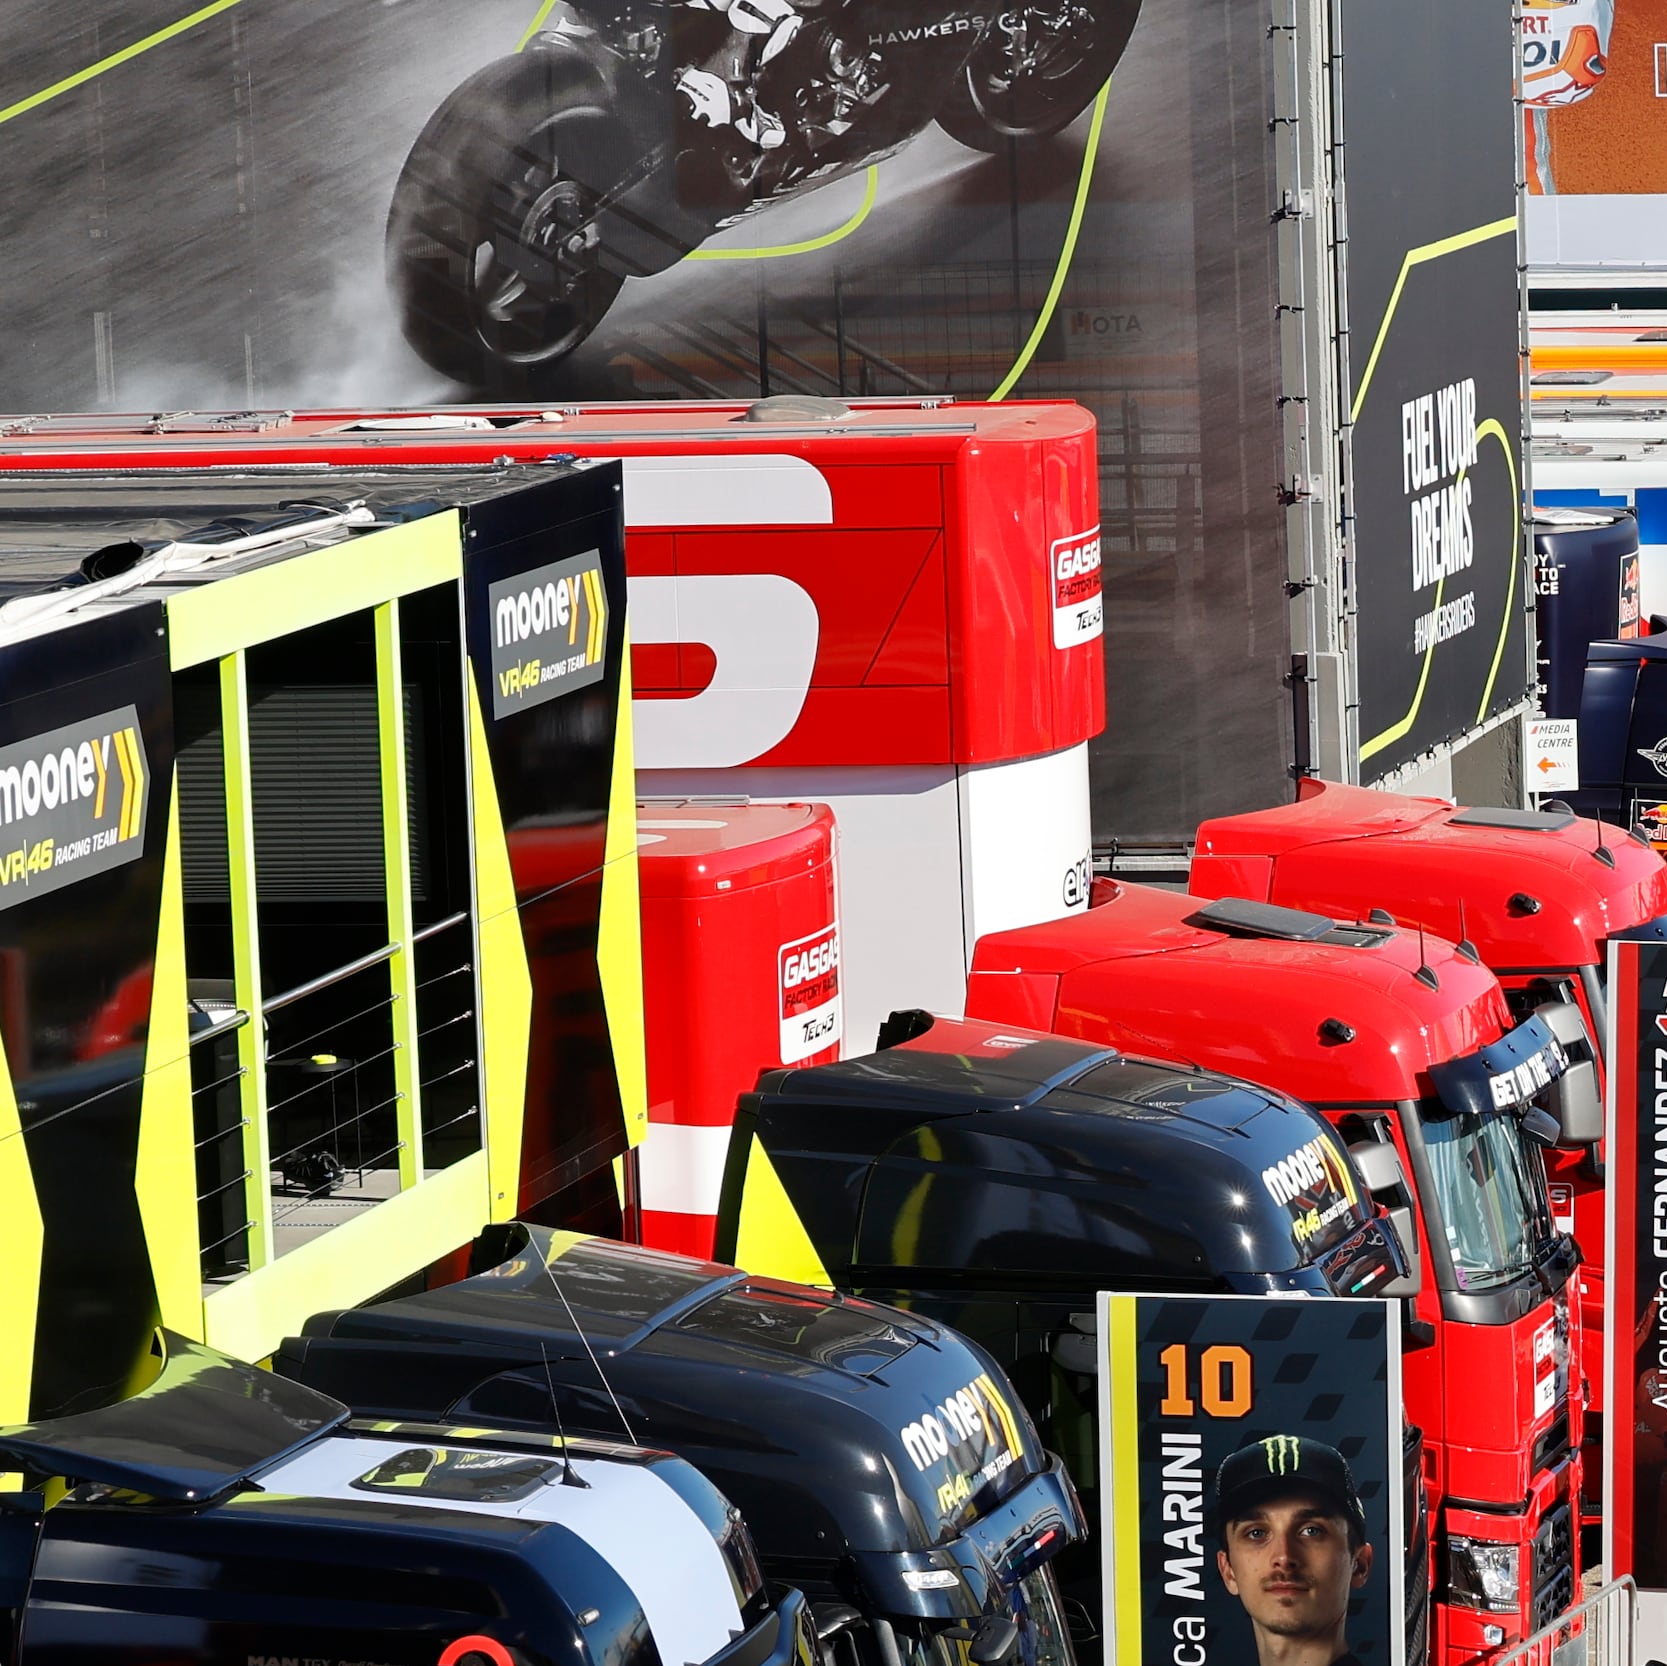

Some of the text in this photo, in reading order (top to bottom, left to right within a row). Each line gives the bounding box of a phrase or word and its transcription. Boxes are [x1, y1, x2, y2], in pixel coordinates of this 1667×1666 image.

[868, 15, 985, 46] HAWKERS
[1402, 377, 1478, 494] FUEL YOUR
[1411, 478, 1475, 592] DREAMS
[496, 574, 582, 648] mooney
[540, 651, 587, 685] RACING TEAM
[1537, 738, 1574, 750] CENTRE
[1538, 724, 1571, 735] MEDIA
[54, 828, 118, 868] RACING TEAM
[1491, 1070, 1519, 1111] GET
[1261, 1139, 1337, 1208] mooney
[1159, 1342, 1254, 1419] 10
[1161, 1432, 1207, 1600] MARINI
